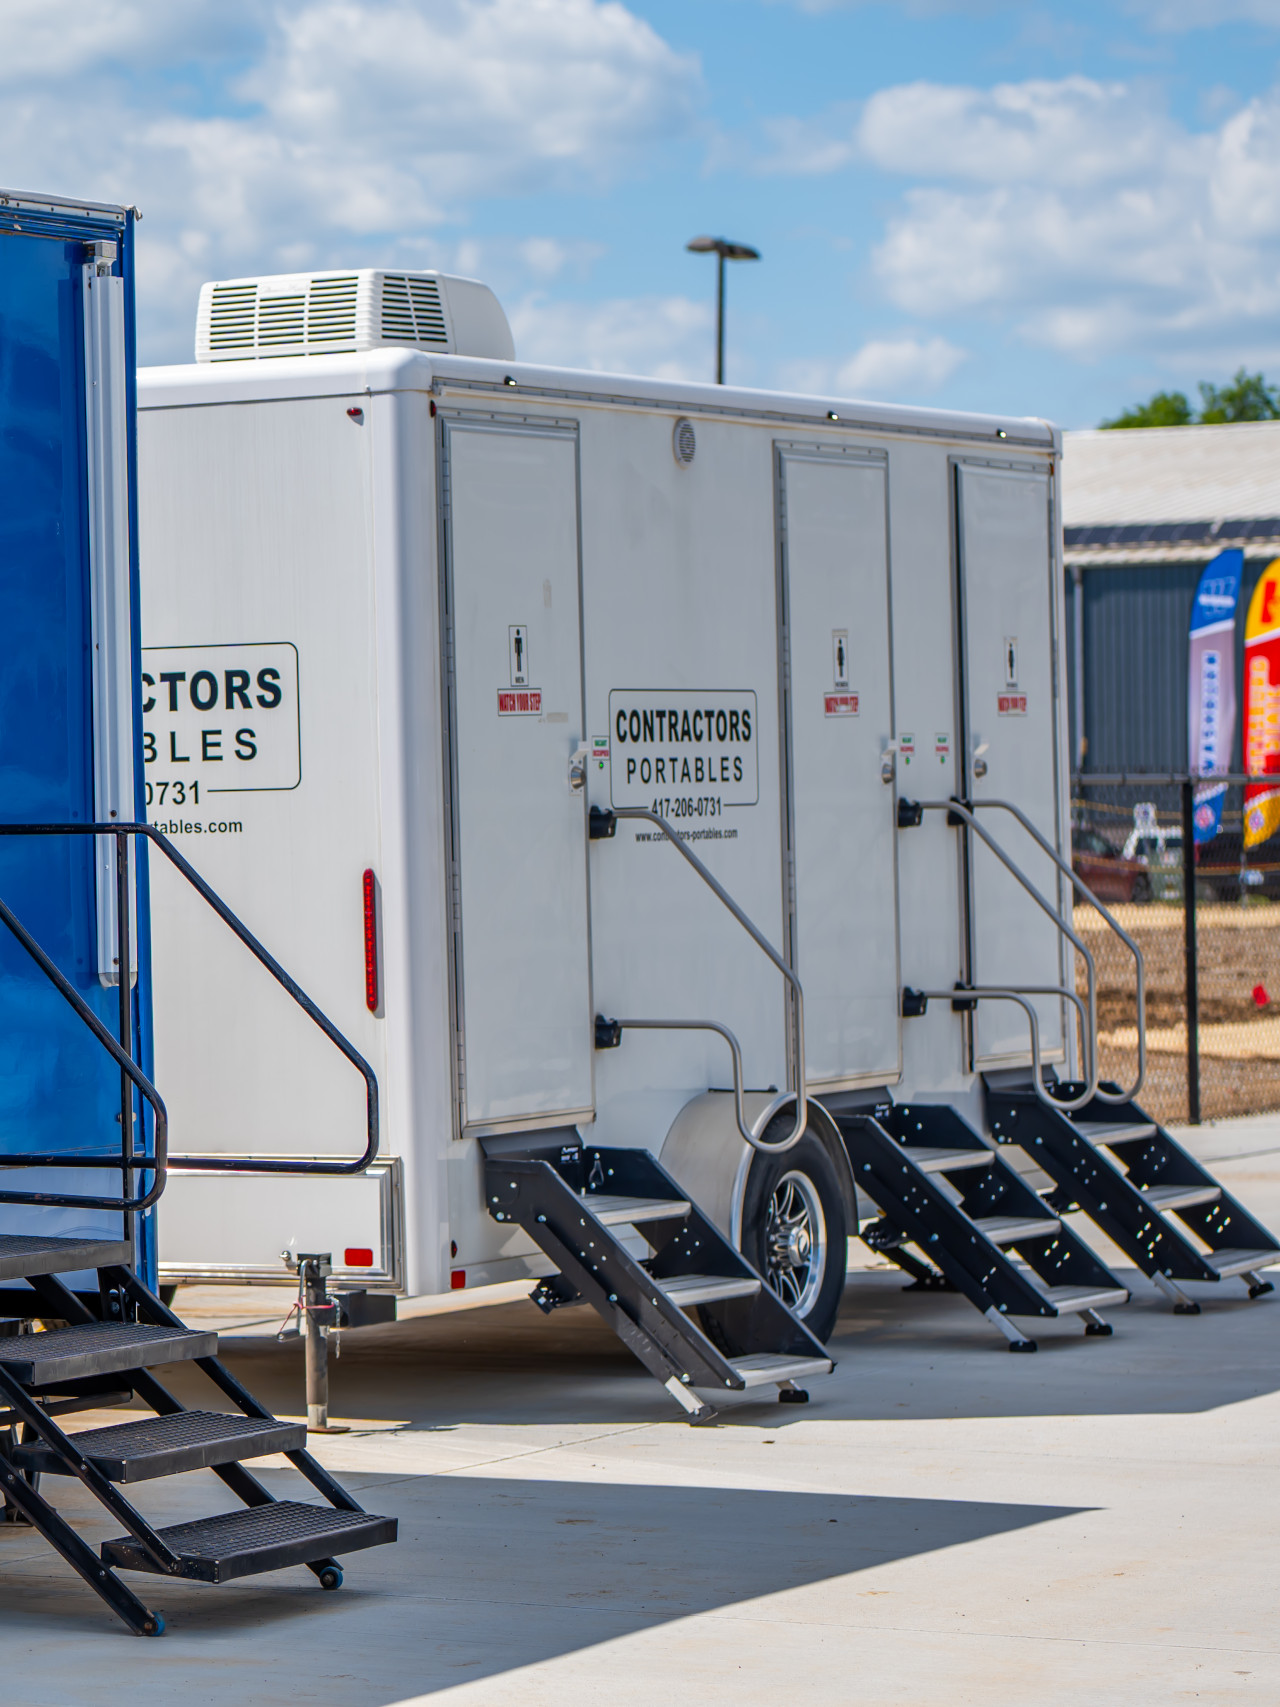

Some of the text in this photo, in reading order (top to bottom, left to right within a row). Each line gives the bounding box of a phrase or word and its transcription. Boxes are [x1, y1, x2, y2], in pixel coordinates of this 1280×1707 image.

[616, 709, 752, 743] CONTRACTORS
[627, 756, 743, 784] PORTABLES
[651, 796, 722, 818] 417-206-0731
[635, 827, 738, 843] www.conttors-portables.com
